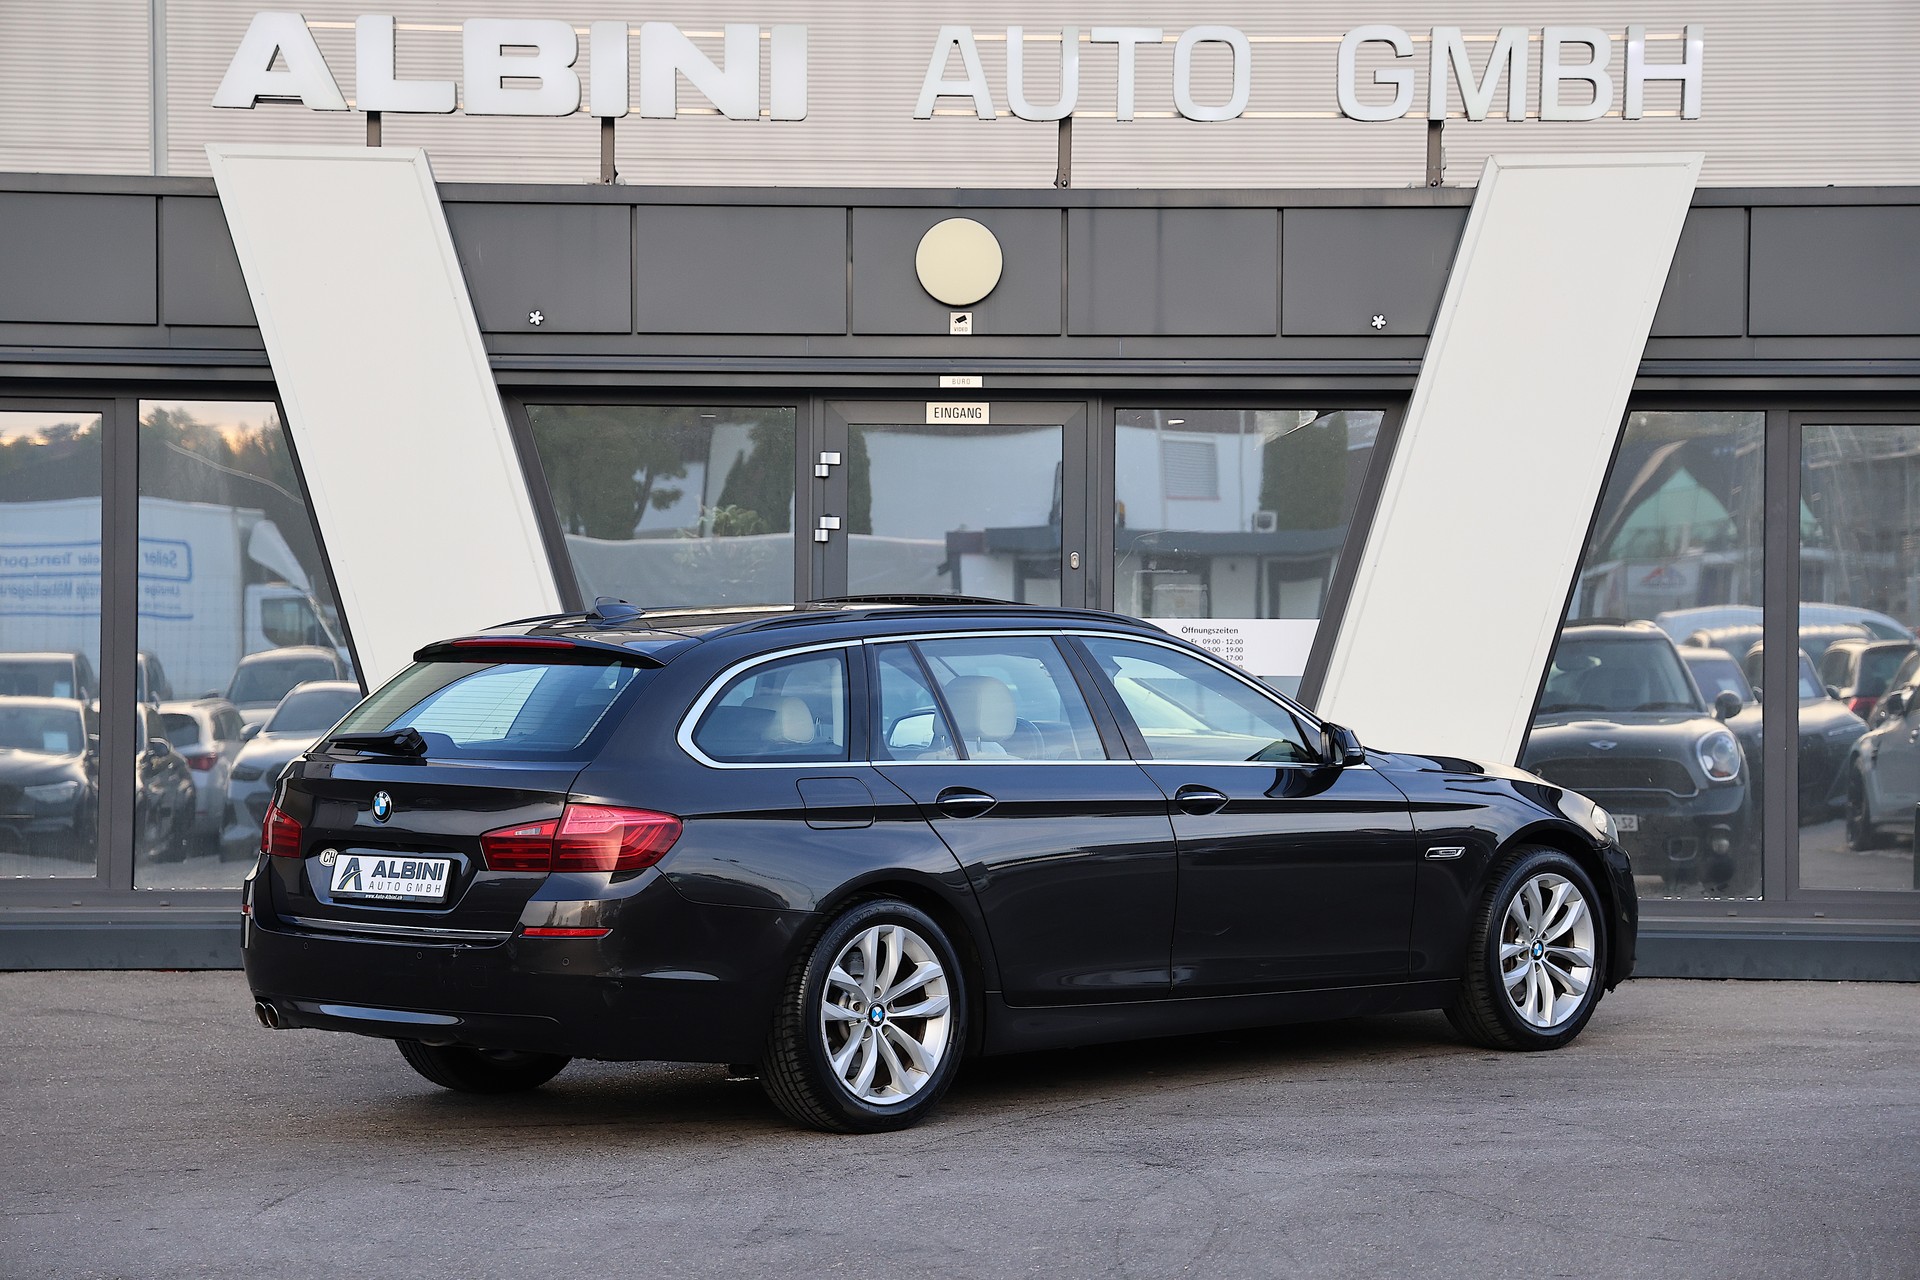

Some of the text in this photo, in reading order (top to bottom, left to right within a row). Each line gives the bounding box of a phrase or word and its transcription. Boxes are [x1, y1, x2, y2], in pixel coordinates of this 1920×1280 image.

[212, 11, 1704, 122] ALBINI AUTO GMBH
[934, 407, 982, 419] EINGANG
[1181, 625, 1239, 635] Öffnungszeiten
[323, 851, 335, 864] CH
[371, 860, 445, 881] ALBINI
[368, 881, 442, 894] AUTO GMBH
